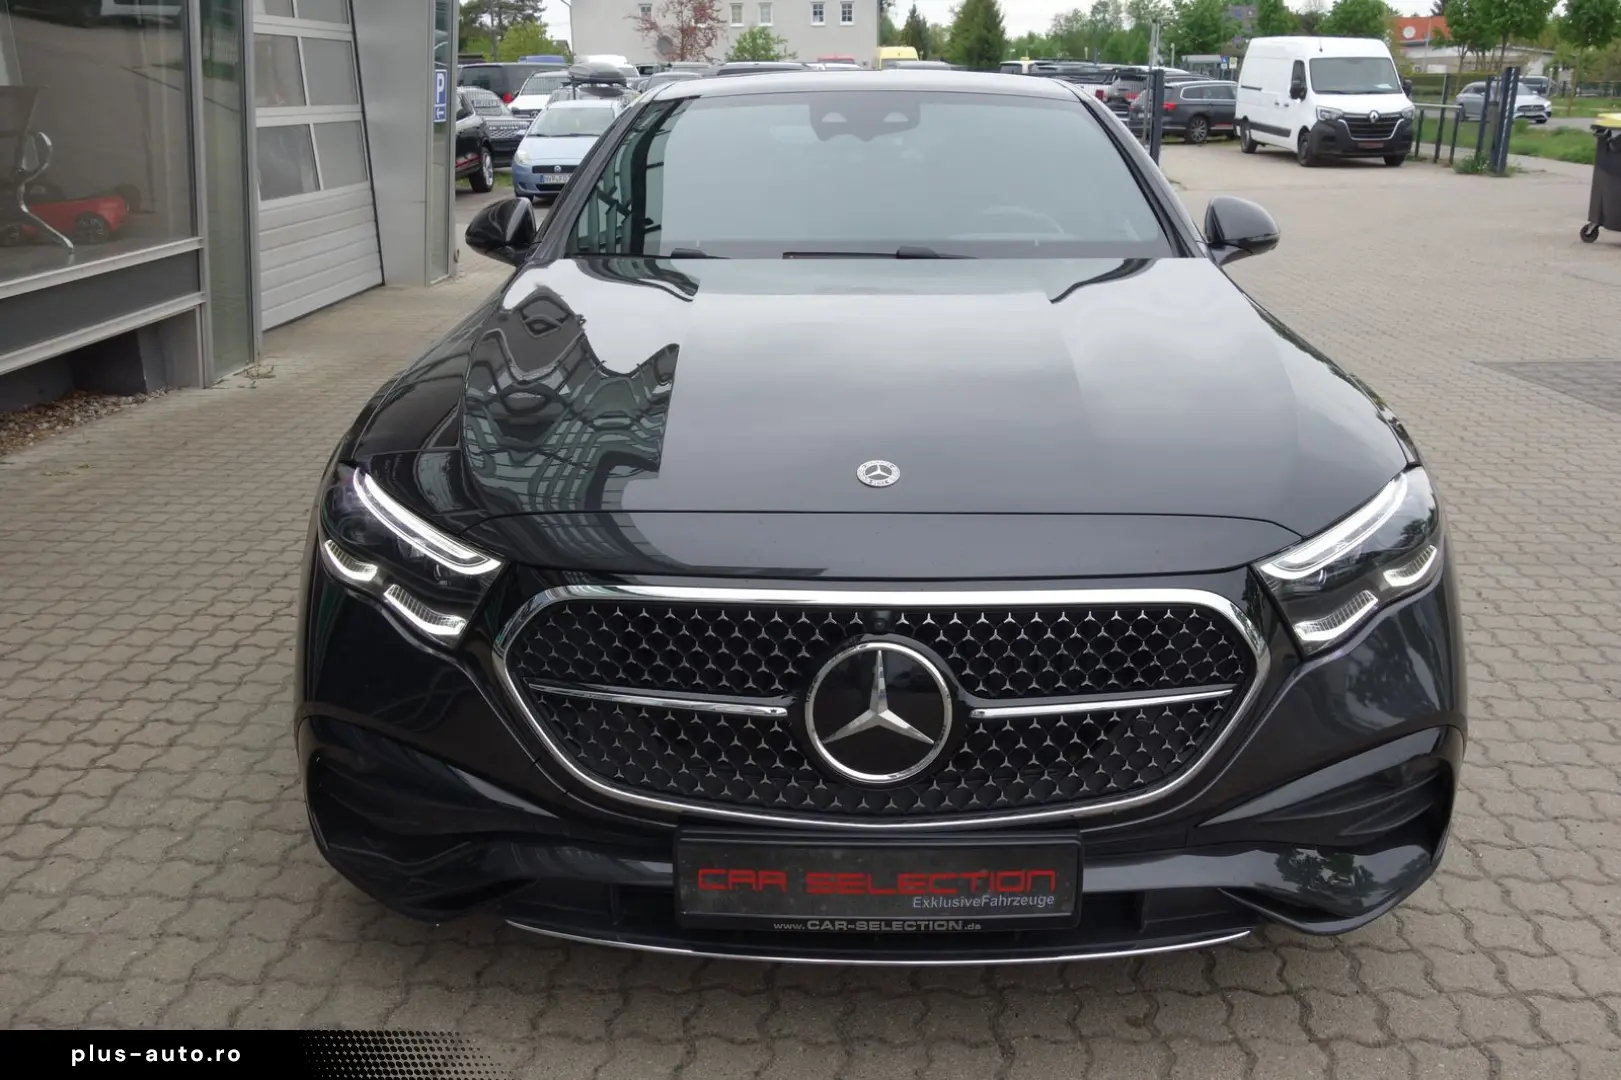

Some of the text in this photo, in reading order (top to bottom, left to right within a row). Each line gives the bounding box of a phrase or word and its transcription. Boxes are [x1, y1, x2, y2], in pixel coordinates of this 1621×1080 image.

[436, 72, 445, 104] P
[698, 868, 1056, 895] CAR SELECTION
[912, 895, 1055, 908] ExklusiveFahrzeuge
[773, 920, 982, 931] www.CAR-SELECTION.de
